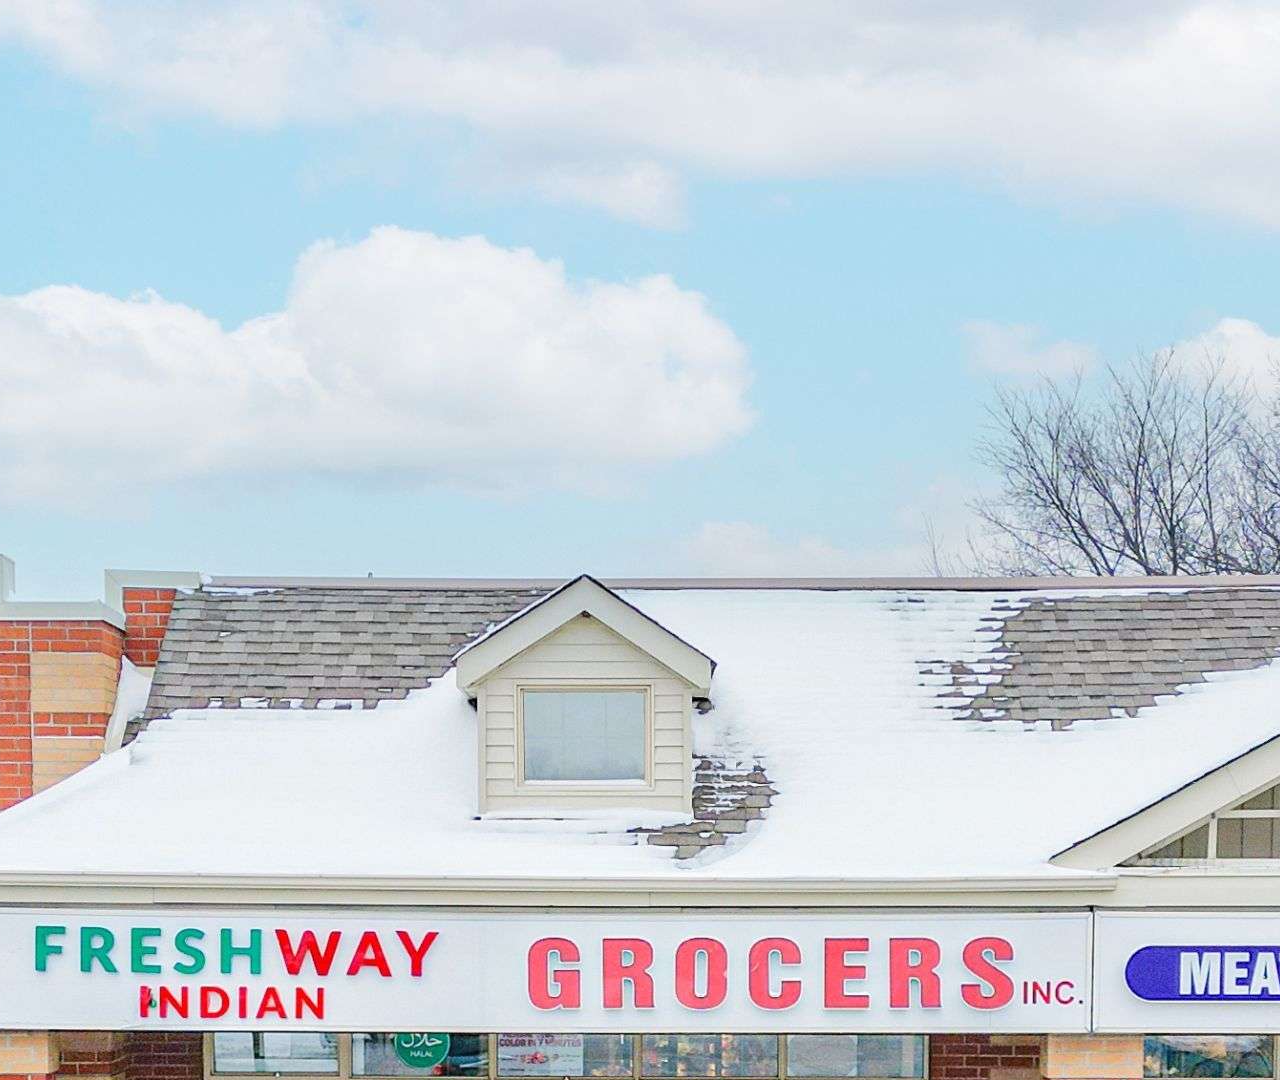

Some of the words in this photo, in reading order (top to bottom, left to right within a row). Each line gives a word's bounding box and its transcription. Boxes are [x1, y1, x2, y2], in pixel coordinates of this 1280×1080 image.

[526, 936, 1015, 1011] GROCERS
[1022, 980, 1084, 1005] INC.
[139, 985, 325, 1020] INDIAN
